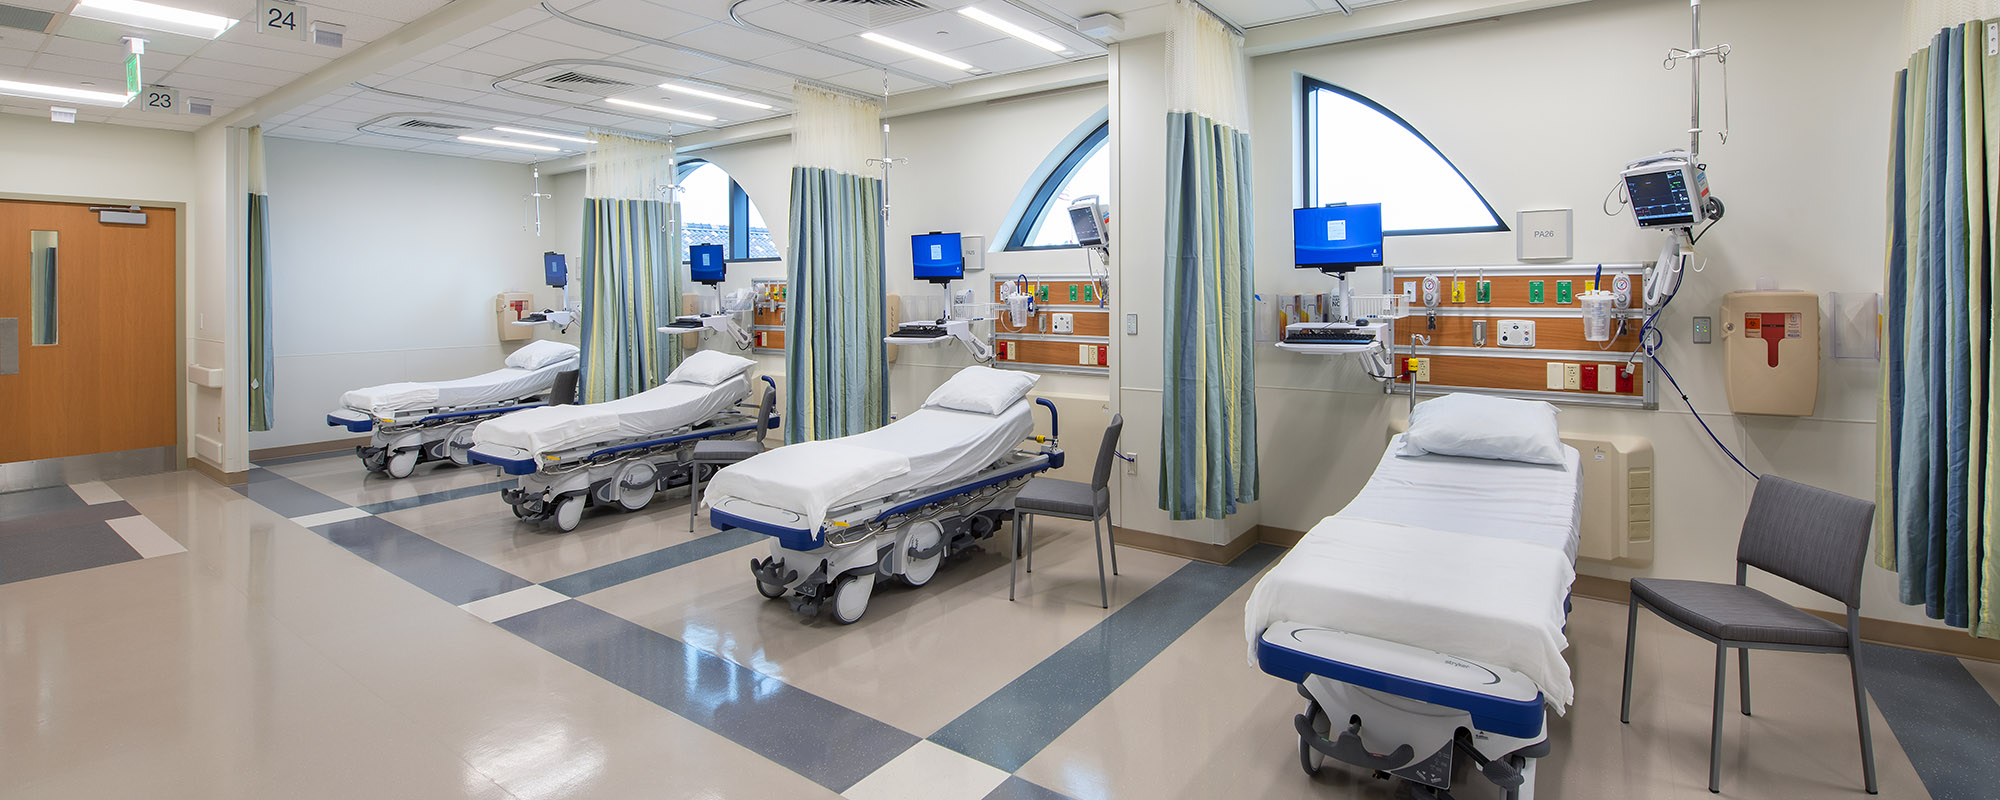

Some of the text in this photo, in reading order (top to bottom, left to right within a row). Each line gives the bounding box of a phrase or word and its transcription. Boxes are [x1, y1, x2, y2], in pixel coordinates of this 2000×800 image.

[268, 8, 296, 30] 24
[149, 92, 171, 108] 23
[1534, 230, 1554, 238] PA26
